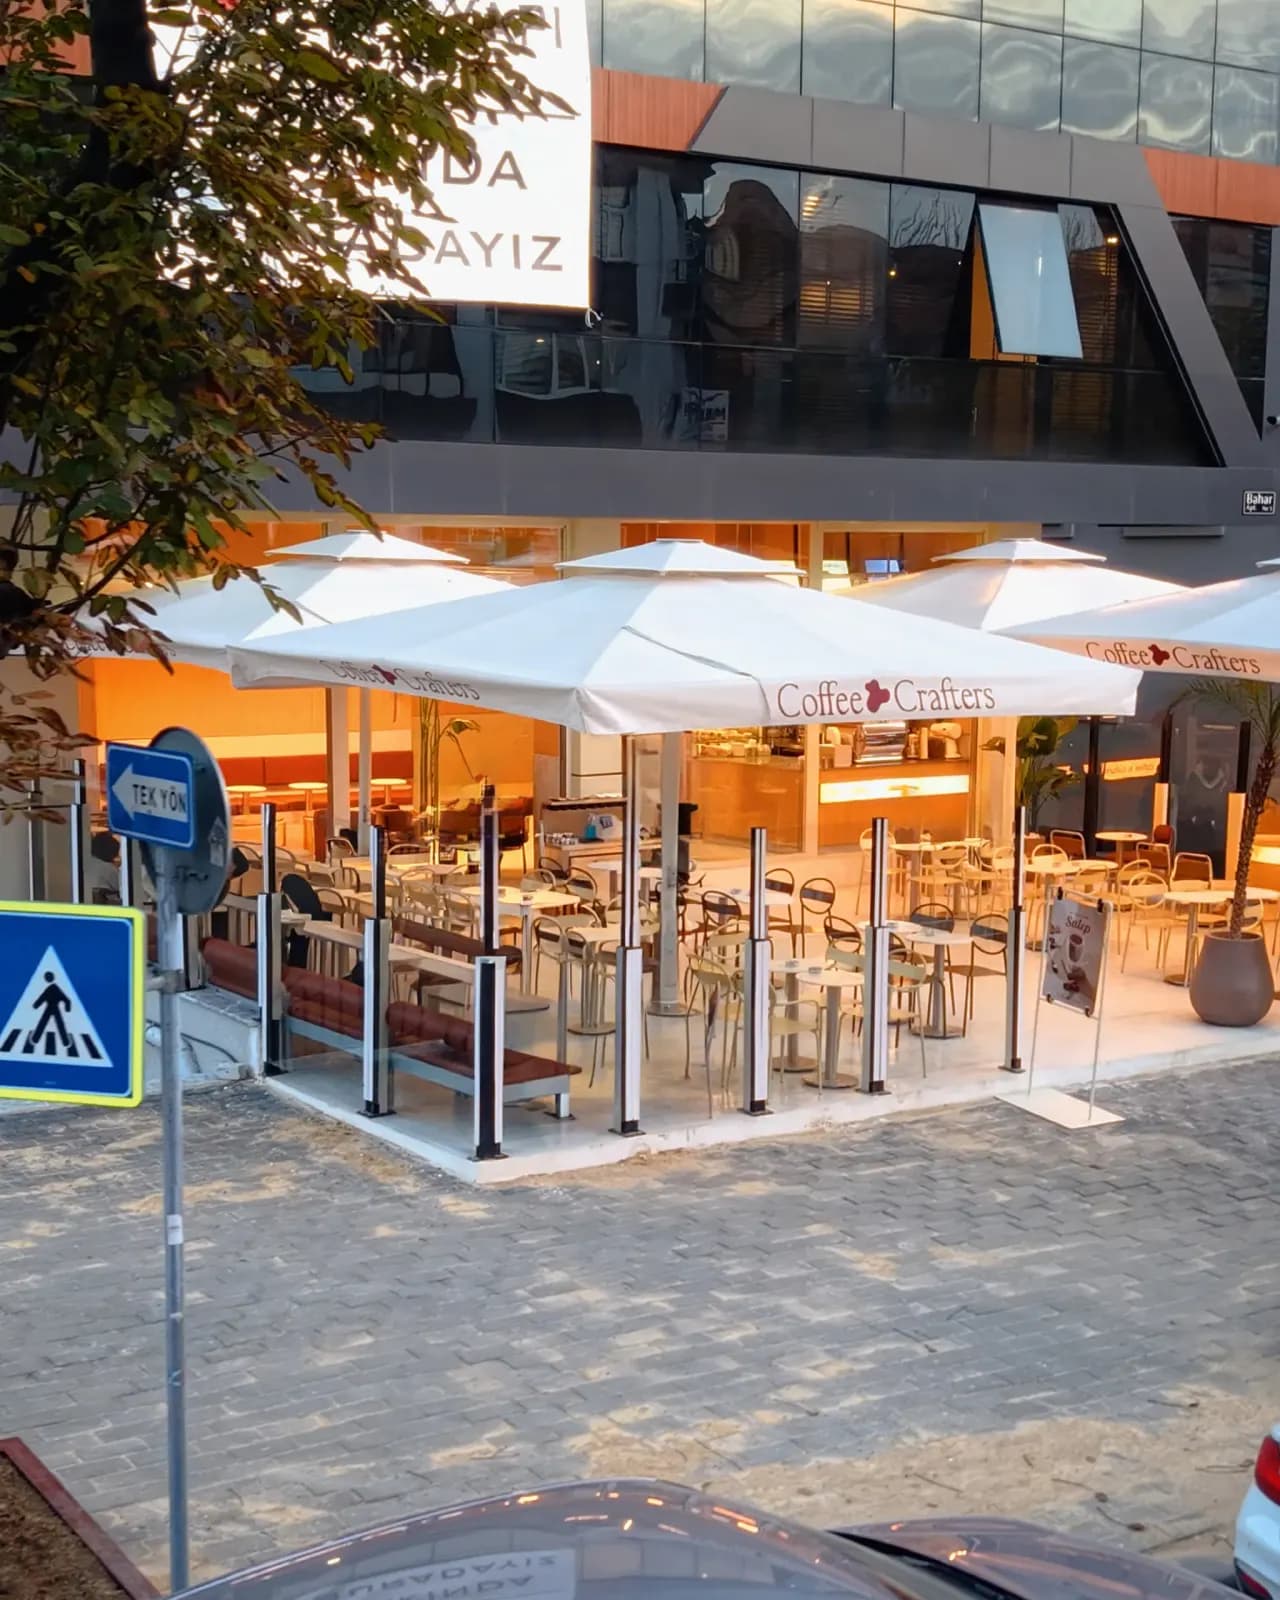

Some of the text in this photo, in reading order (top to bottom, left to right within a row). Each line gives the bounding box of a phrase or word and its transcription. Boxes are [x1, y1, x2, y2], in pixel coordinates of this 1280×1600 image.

[1172, 646, 1261, 674] Crafters
[778, 677, 996, 718] Coffee Crafters
[132, 784, 187, 813] TEK YÖN
